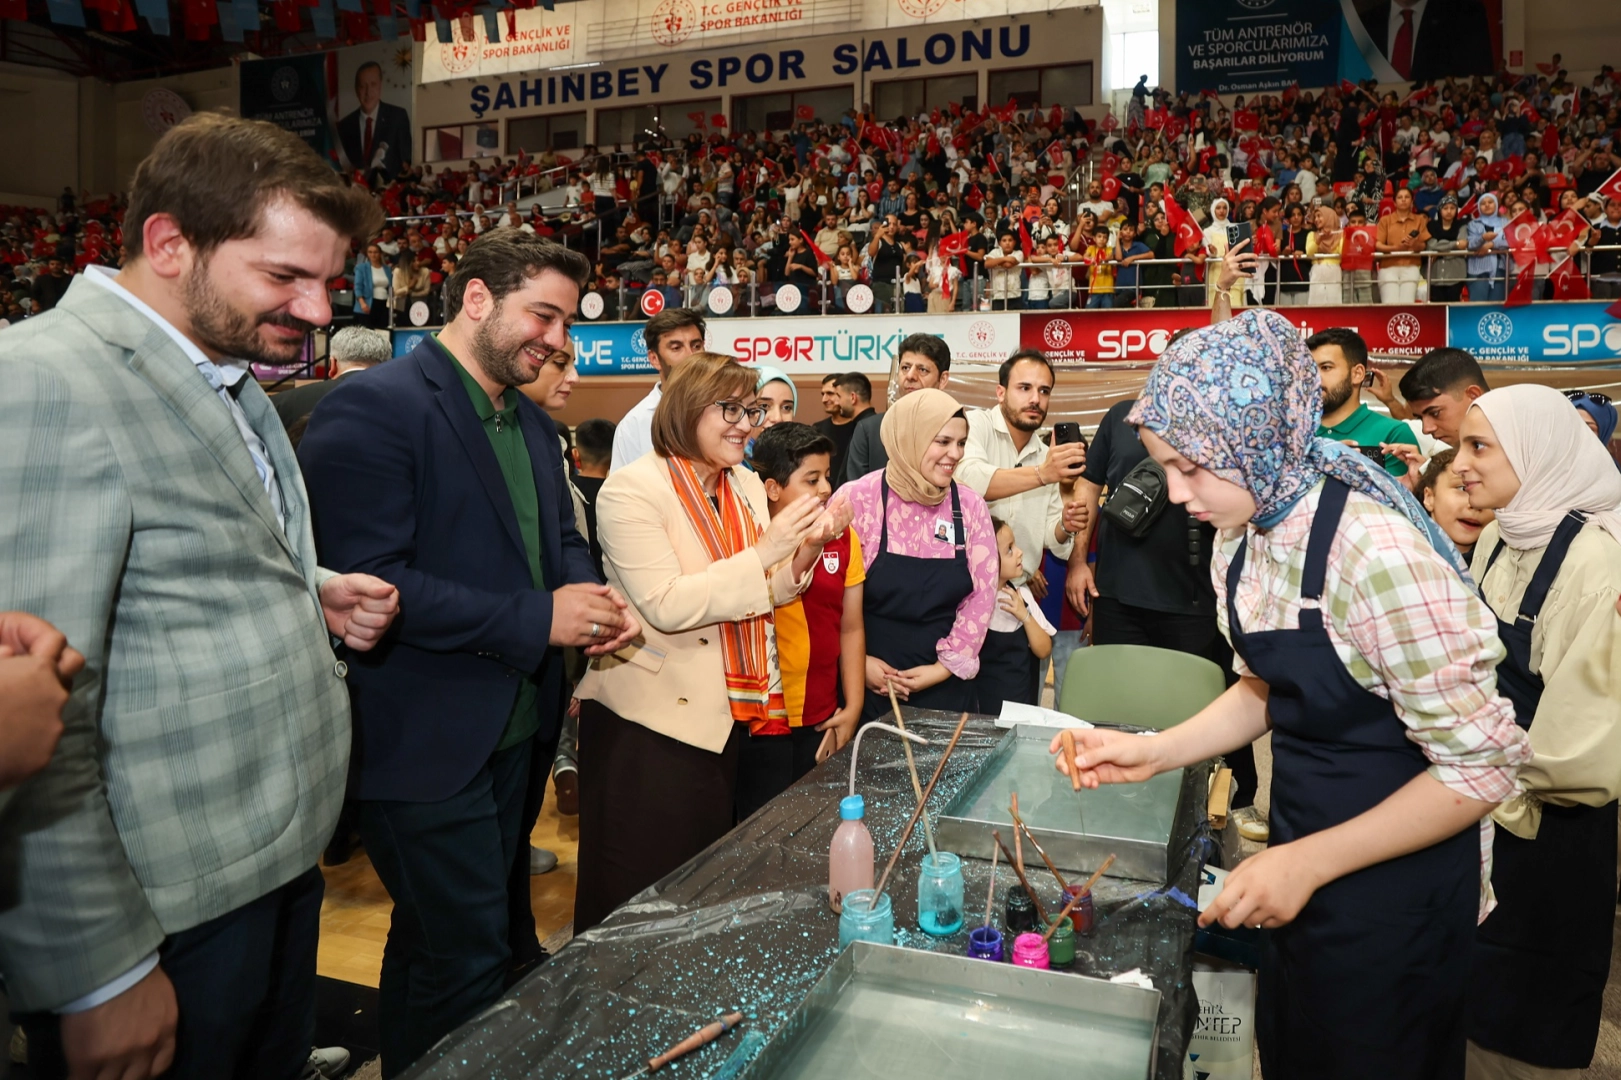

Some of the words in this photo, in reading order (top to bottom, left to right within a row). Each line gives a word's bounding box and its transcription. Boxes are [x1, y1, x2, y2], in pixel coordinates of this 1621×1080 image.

[701, 4, 722, 17] T.C.
[700, 18, 731, 32] SPOR
[735, 8, 802, 27] BAKANLIĞI
[556, 25, 571, 36] VE
[1203, 27, 1234, 42] TÜM
[1237, 21, 1313, 39] ANTRENÖR
[483, 47, 510, 60] SPOR
[512, 39, 570, 56] BAKANLIĞI
[1188, 44, 1204, 57] VE
[1208, 34, 1329, 56] SPORCULARIMIZA
[689, 49, 806, 90] SPOR
[832, 24, 1030, 75] SALONU
[1193, 55, 1257, 70] BAŞARILAR
[1258, 50, 1325, 65] DİLİYORUM
[1218, 83, 1230, 92] Dr.
[1230, 82, 1257, 91] Osman
[968, 350, 997, 359] GENÇLİK
[1075, 349, 1086, 357] VE
[1387, 345, 1423, 356] GENÇLİK
[1478, 345, 1516, 356] GENÇLİK
[1517, 346, 1529, 354] VE
